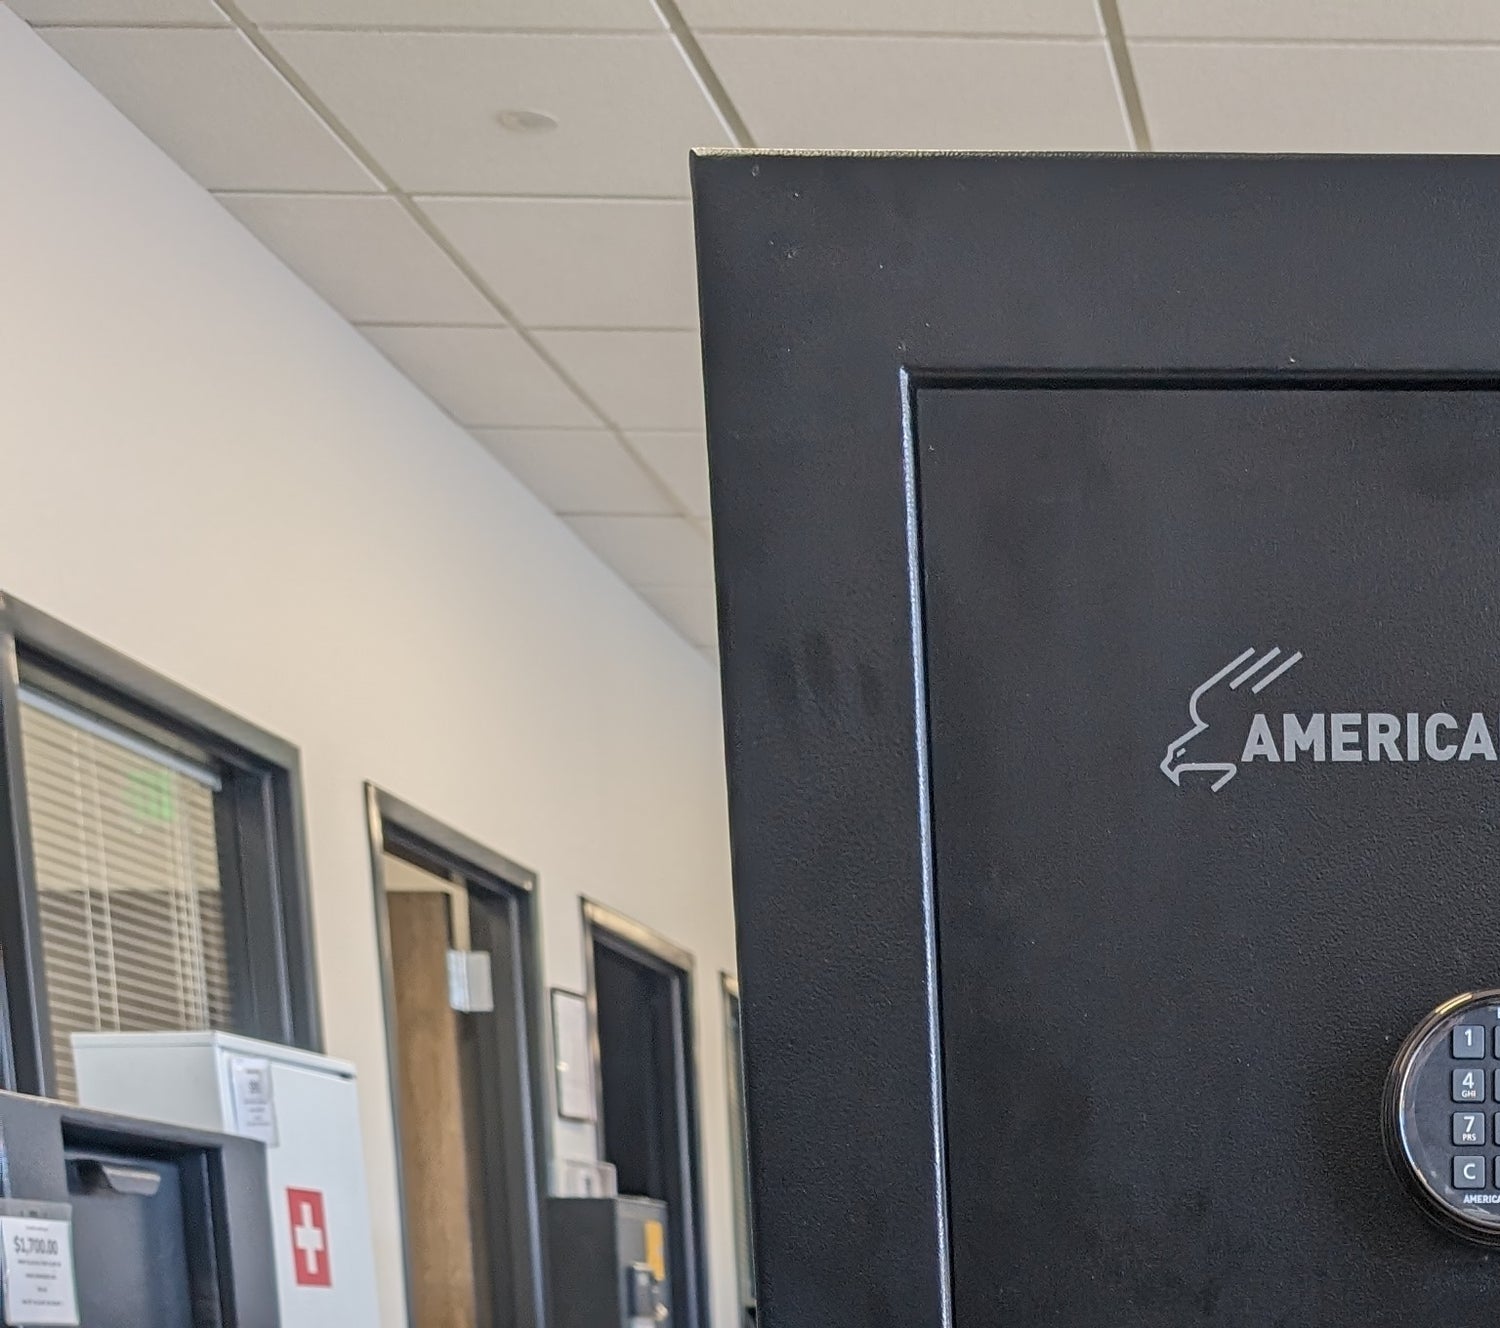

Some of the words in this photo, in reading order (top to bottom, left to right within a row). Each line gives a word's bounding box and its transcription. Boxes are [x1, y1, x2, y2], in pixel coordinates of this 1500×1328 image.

[1464, 1028, 1473, 1046] 1
[1462, 1072, 1475, 1089] 4
[1461, 1090, 1476, 1098] GHI
[1463, 1115, 1475, 1133] 7
[1462, 1133, 1477, 1142] PRS
[1463, 1163, 1476, 1180] C
